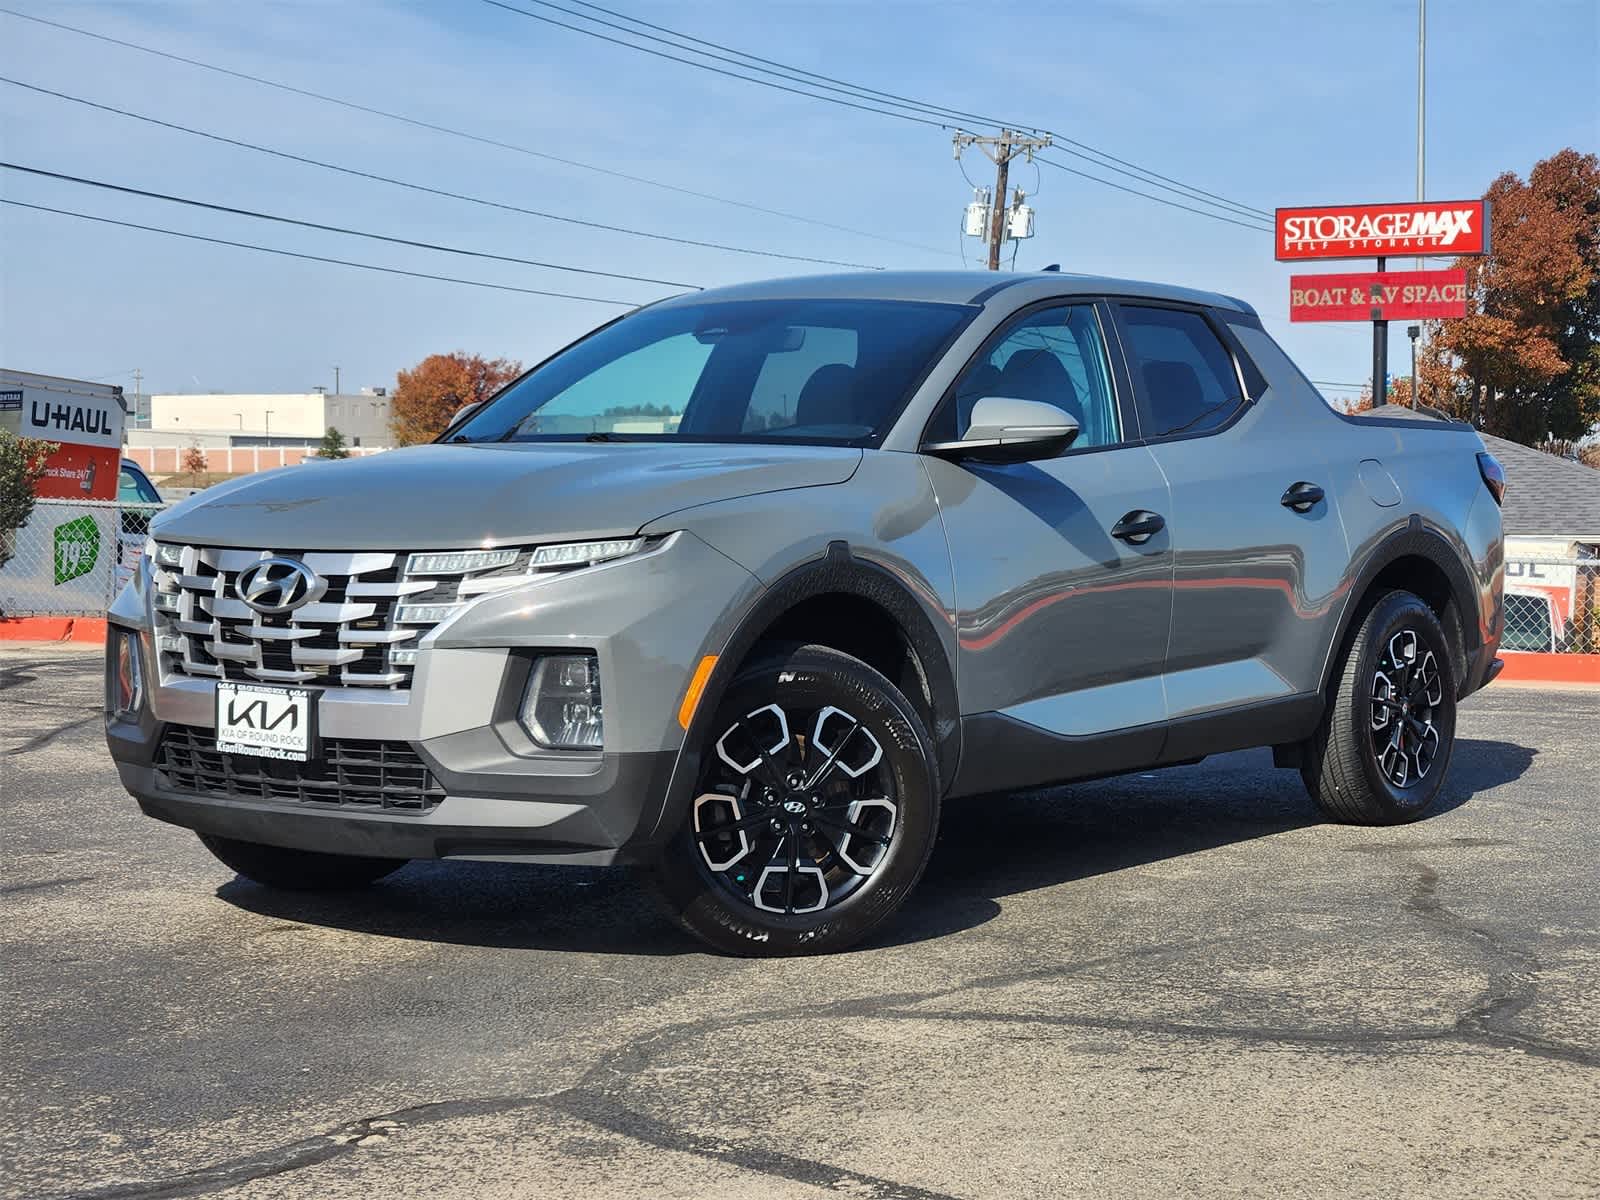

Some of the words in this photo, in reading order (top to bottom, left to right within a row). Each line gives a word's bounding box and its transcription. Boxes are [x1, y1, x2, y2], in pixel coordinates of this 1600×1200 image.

[1284, 240, 1328, 251] SELF
[1349, 237, 1438, 249] STORAGE
[1292, 288, 1347, 307] BOAT
[1350, 287, 1366, 305] &
[44, 466, 59, 478] ruck
[228, 699, 298, 732] KIA
[221, 728, 236, 738] KIA
[237, 730, 248, 739] OF
[248, 731, 279, 744] ROUND
[280, 735, 304, 746] ROCK
[216, 741, 307, 761] KiaofRoundRock.com
